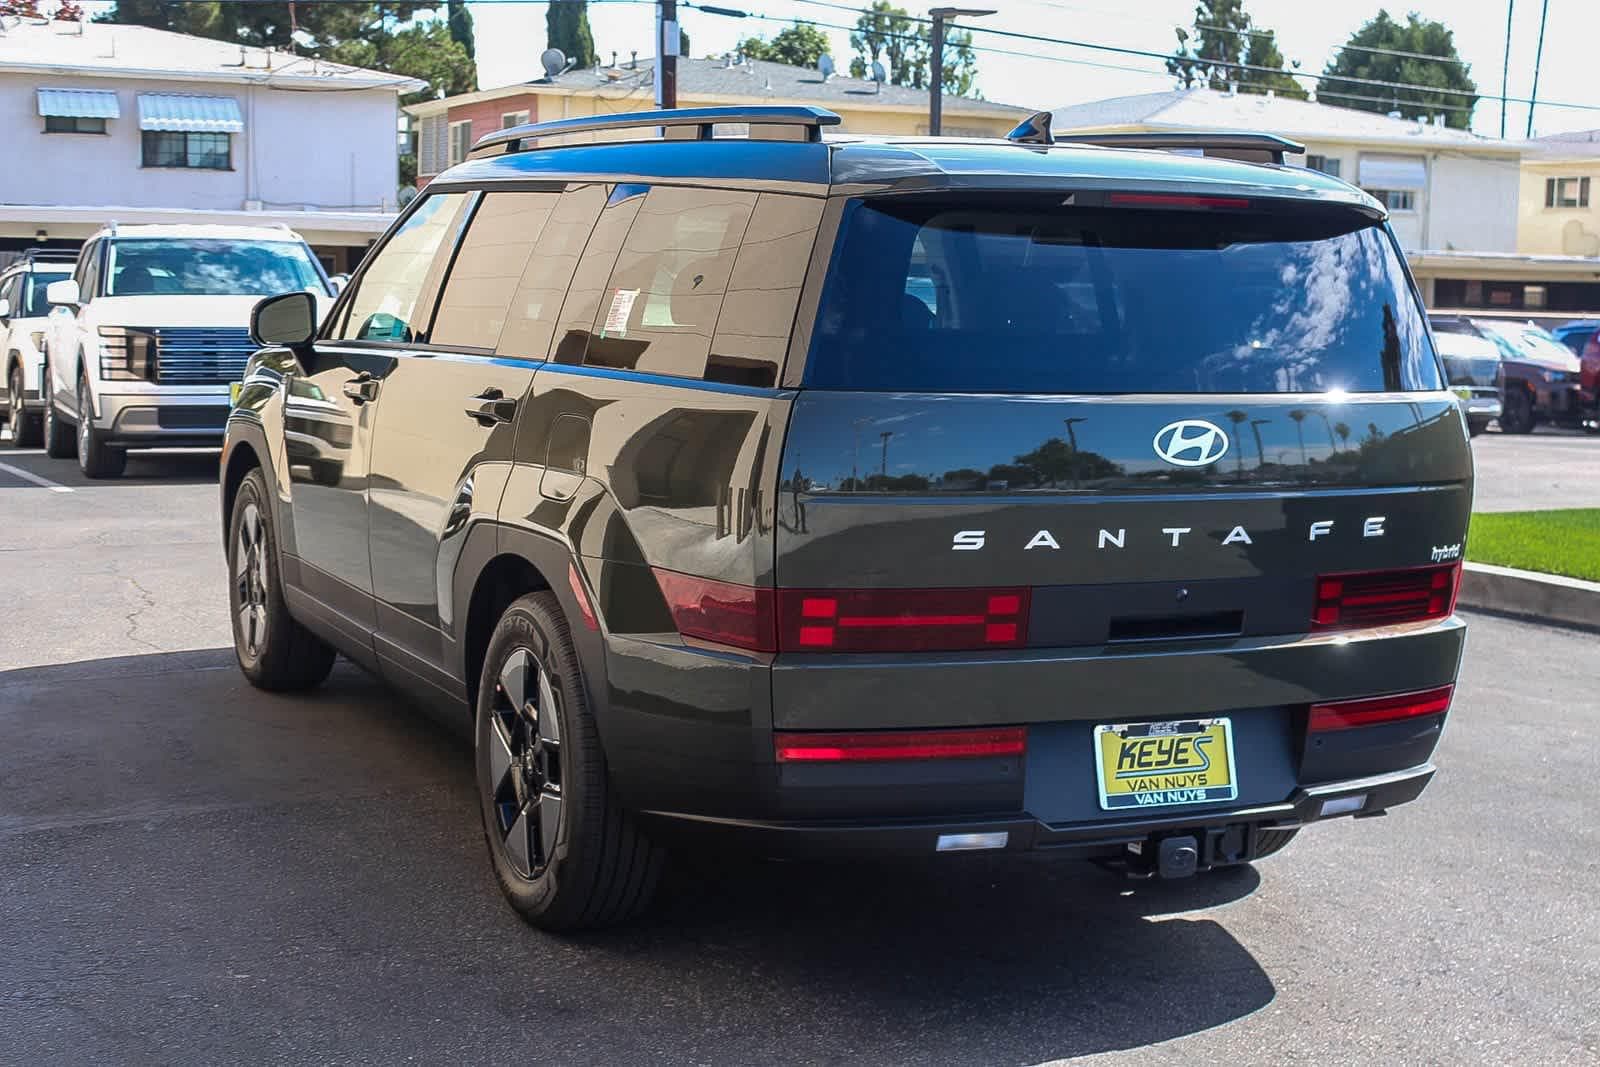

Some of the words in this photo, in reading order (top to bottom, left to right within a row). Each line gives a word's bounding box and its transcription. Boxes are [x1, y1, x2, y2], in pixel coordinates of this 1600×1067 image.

[951, 526, 1253, 550] SANTA
[1309, 516, 1386, 541] FE
[1431, 543, 1461, 563] hybrid
[1115, 736, 1213, 779] KEYES
[1127, 778, 1160, 793] VAN
[1165, 774, 1208, 789] NUYS
[1135, 792, 1162, 805] VAN
[1167, 789, 1207, 803] NUYS
